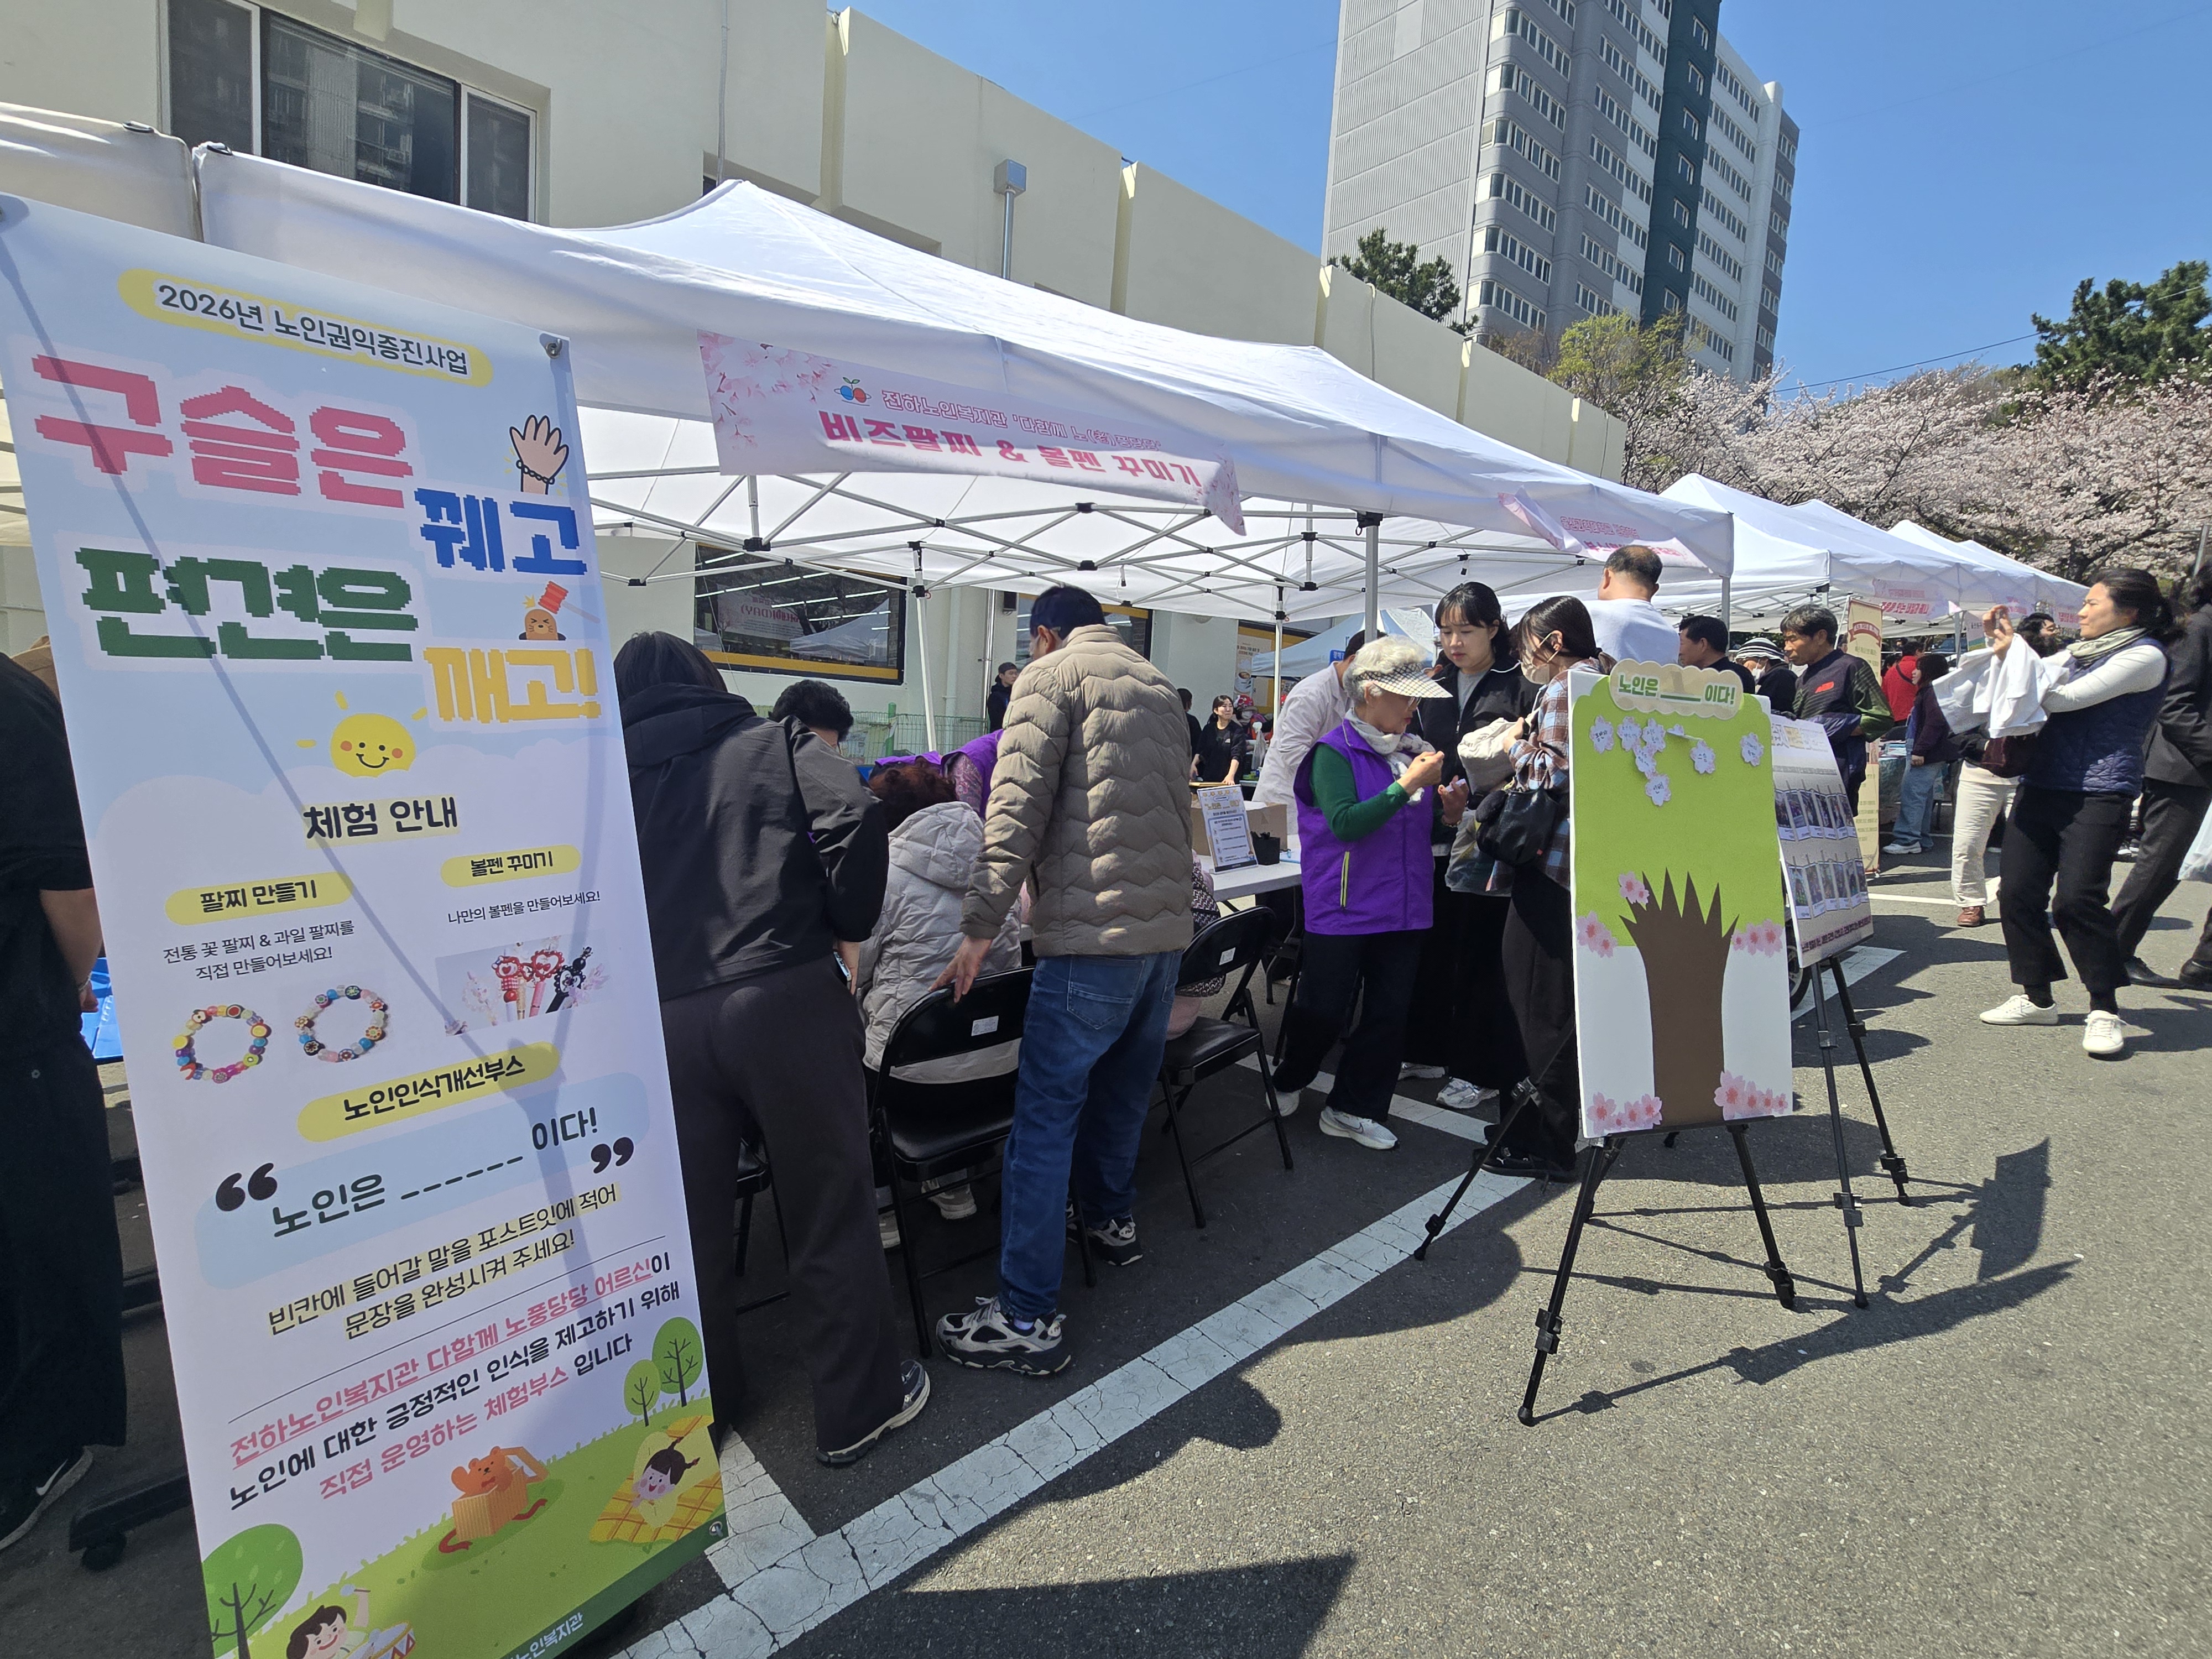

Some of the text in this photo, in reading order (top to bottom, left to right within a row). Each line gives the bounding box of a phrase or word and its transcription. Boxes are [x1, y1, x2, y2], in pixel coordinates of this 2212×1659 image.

[158, 285, 468, 375] 2026년 노인권익증진사업
[32, 354, 414, 508] 구슬은
[882, 390, 1008, 429] 전하노인복지관
[818, 410, 1202, 487] 비즈팔찌 & 볼펜 꾸미기
[415, 488, 587, 576] 꿰고
[75, 547, 419, 662] 편견은
[424, 647, 602, 724] 깨고!
[1618, 675, 1735, 705] 노인은 이다!
[304, 796, 458, 841] 체험 안내
[200, 879, 317, 913] 팔찌 만들기
[470, 851, 554, 878] 볼펜 꾸미기
[163, 919, 355, 965] 전통 꽃 팔찌 & 과일 팔찌를
[447, 891, 601, 925] 나만의 볼펜을 만들어보세요!
[195, 945, 333, 982] 직접 만들어보세요!
[343, 1054, 526, 1123] 노인인식개선부스
[272, 1106, 598, 1239] 노인은 이다!
[268, 1183, 618, 1336] 빈칸에 들어갈 말을 포스트잇에 적어
[345, 1229, 576, 1340] 문장을 완성시켜 주세요!
[230, 1252, 671, 1468] 전하노인복지관 다함께 노풍당당 어르신이
[230, 1281, 681, 1511] 노인에 대한 긍정적인 인식을 제고하기 위해
[319, 1333, 633, 1501] 직접 운영하는 체험부스 입니다
[509, 1612, 583, 1659] 노인복지관
